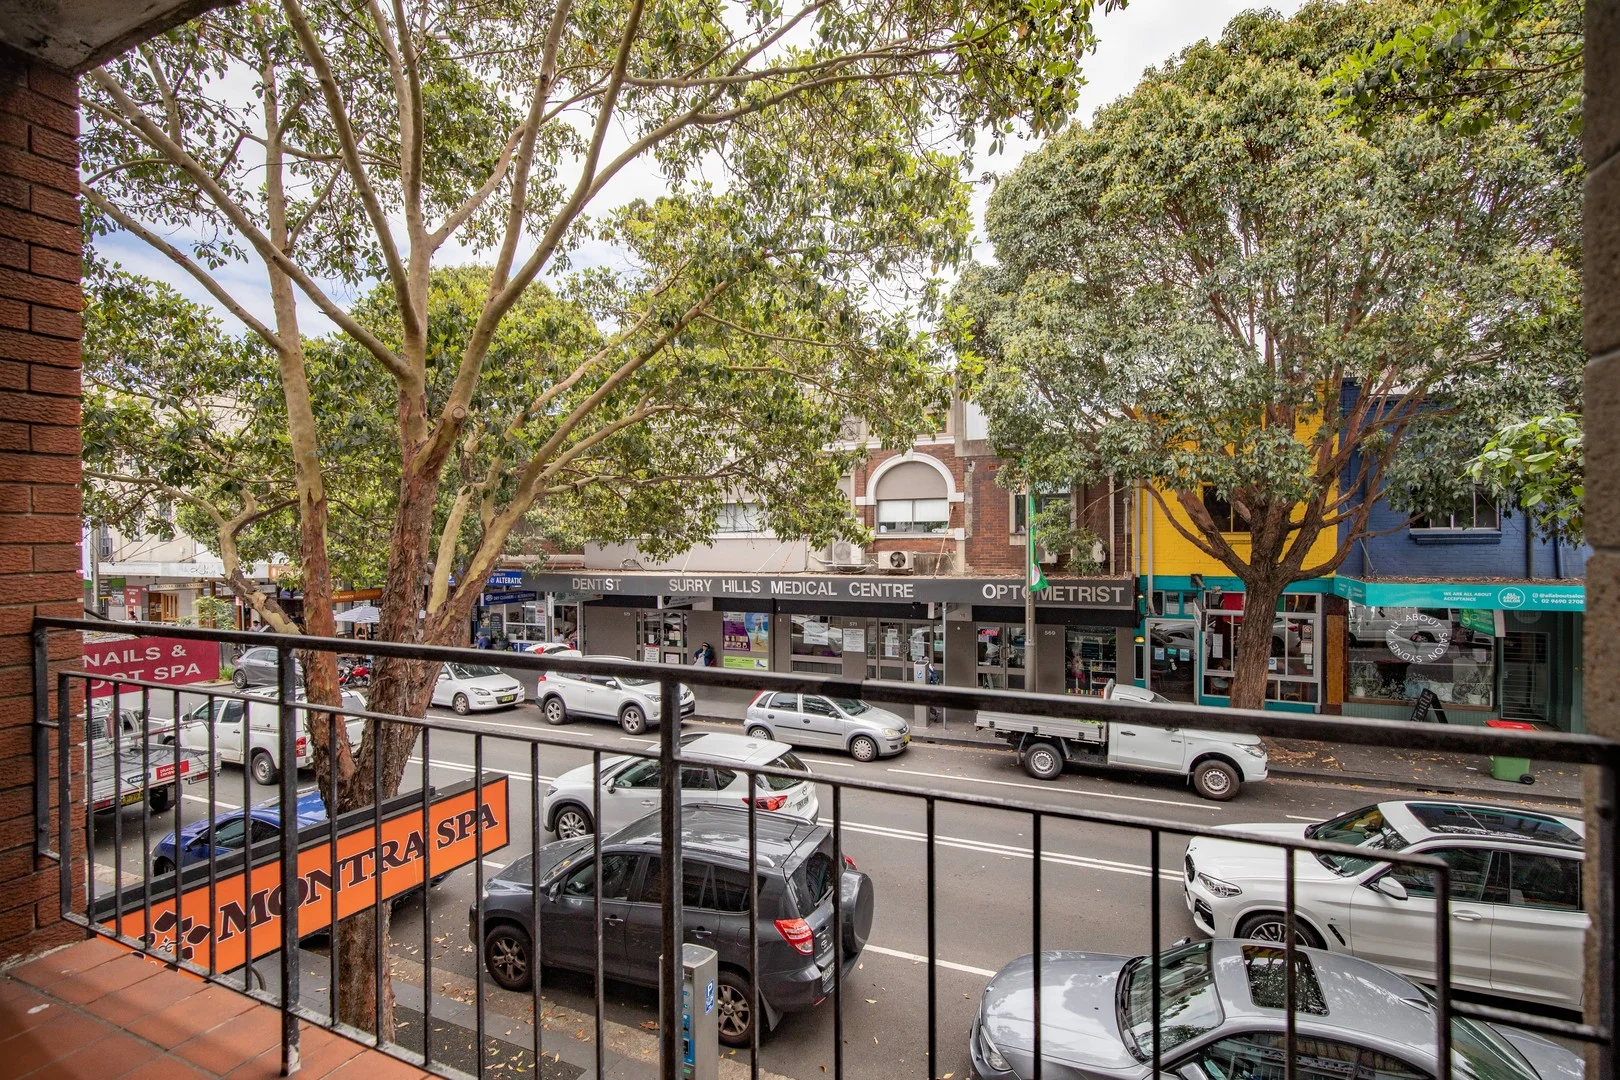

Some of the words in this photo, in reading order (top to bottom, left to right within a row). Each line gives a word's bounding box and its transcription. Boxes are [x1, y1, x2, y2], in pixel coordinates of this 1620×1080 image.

[572, 578, 621, 590] DENTIST
[669, 579, 712, 592] SURRY
[722, 580, 761, 593] HILLS
[771, 580, 837, 596] MEDICAL
[849, 581, 914, 598] CENTRE
[1388, 621, 1402, 635] ALL
[1405, 613, 1442, 628] ABOUT
[1388, 640, 1422, 663] SYDNEY
[1428, 633, 1448, 660] SALON
[82, 647, 160, 668] NAILS
[171, 645, 187, 657] &
[154, 663, 201, 680] SPA
[217, 830, 425, 944] MONTRA
[436, 802, 499, 850] SPA
